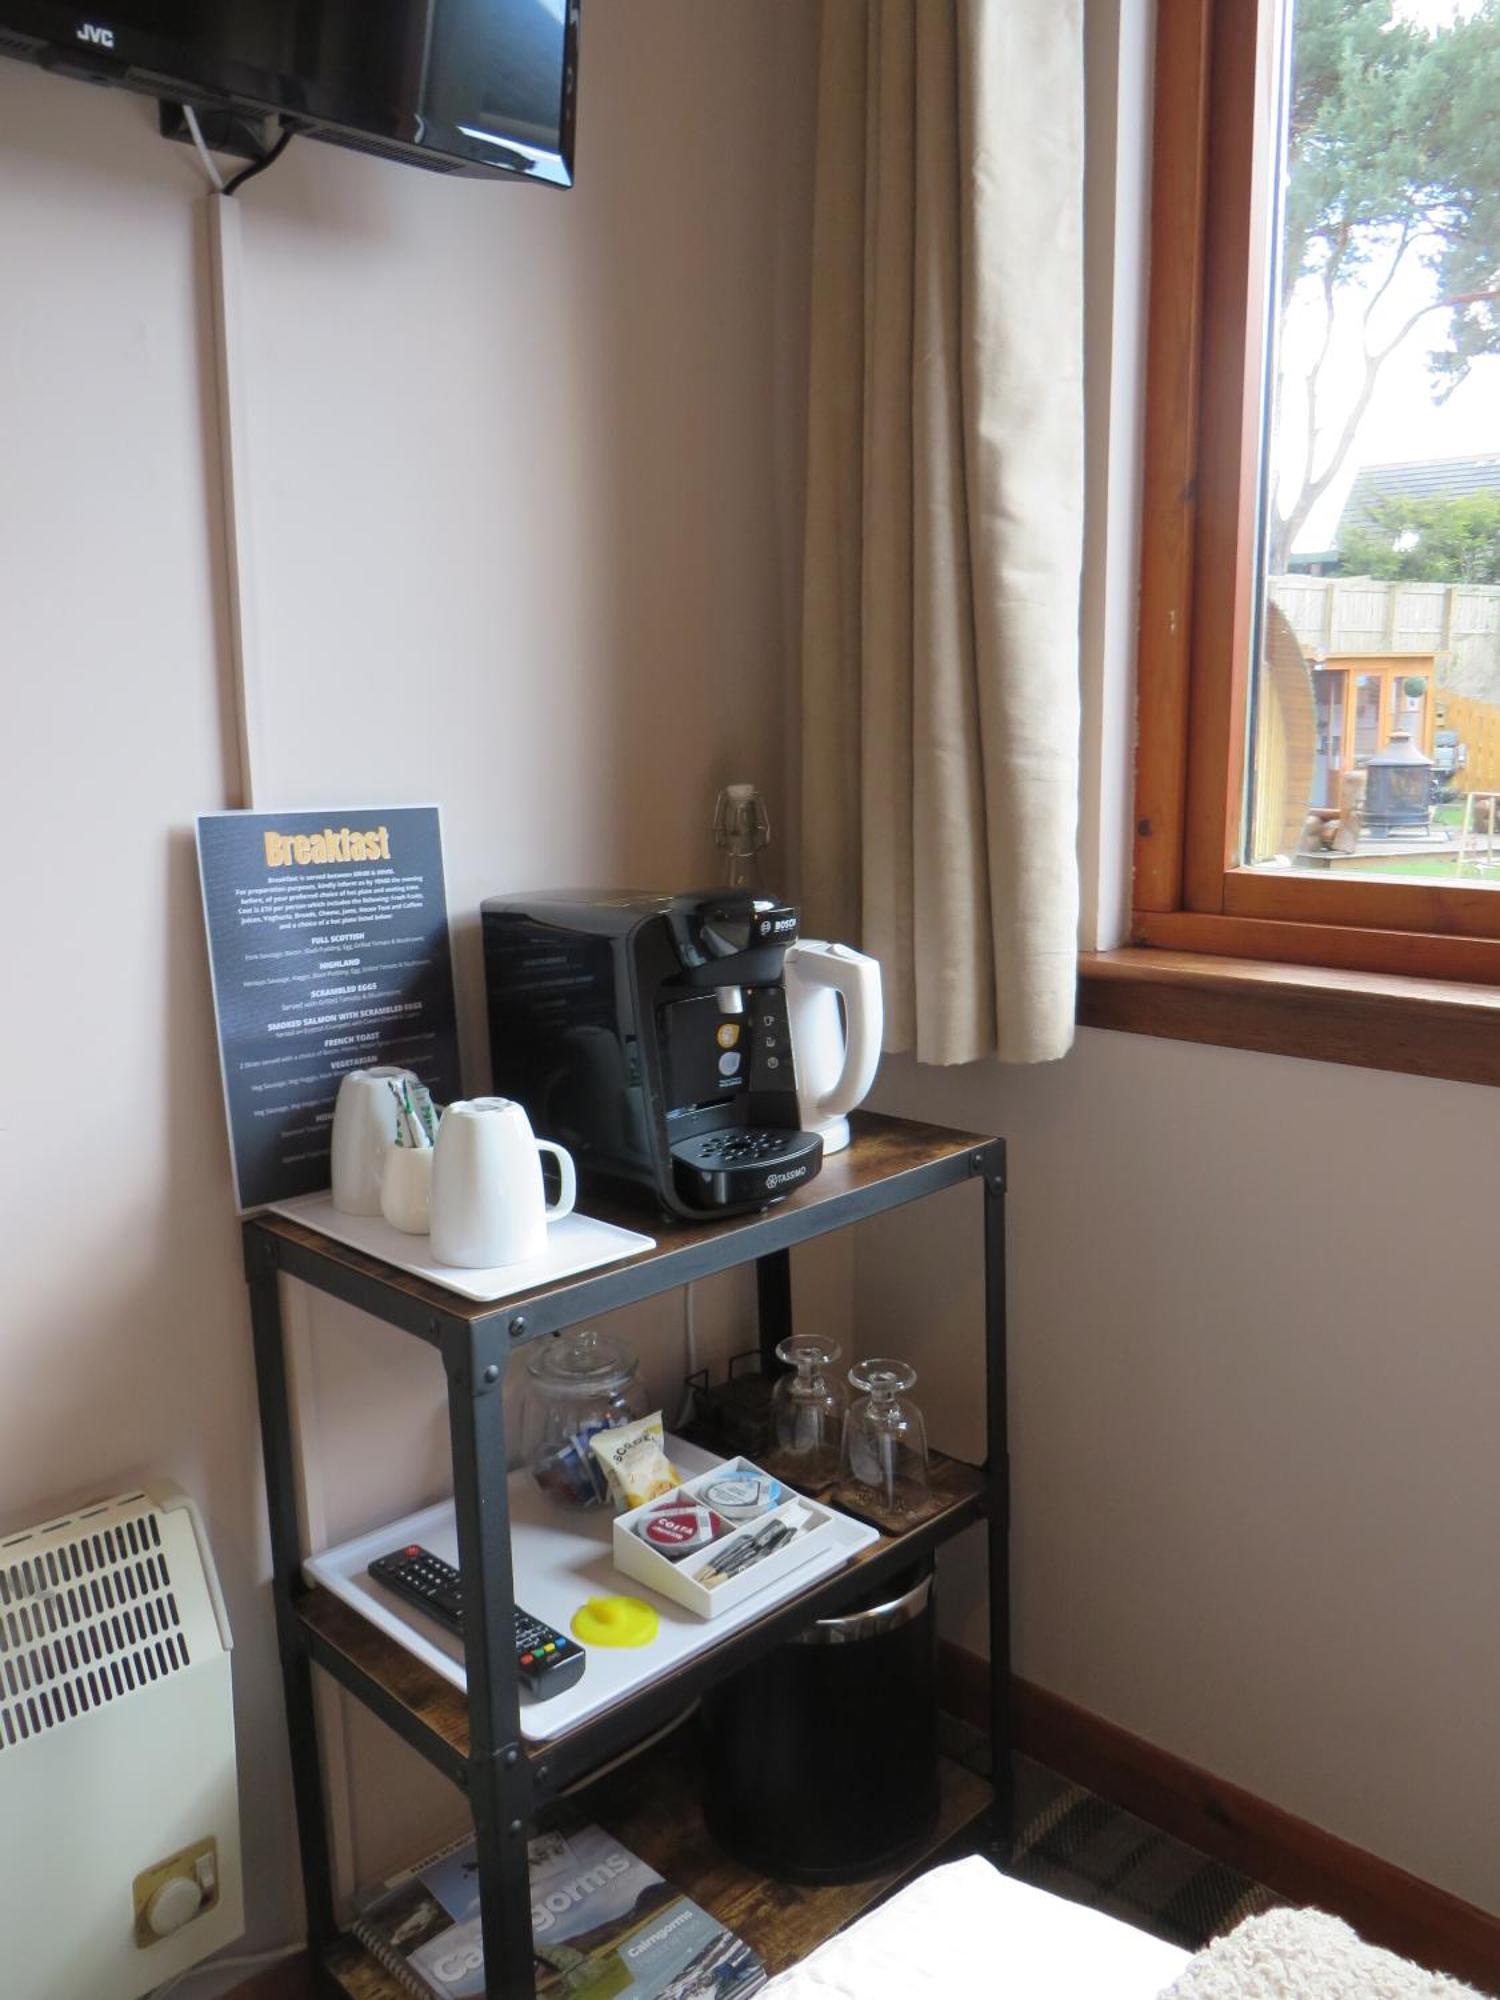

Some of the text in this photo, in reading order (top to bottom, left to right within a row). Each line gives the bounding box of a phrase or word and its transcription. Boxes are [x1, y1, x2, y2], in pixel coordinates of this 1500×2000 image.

[77, 23, 114, 48] JVC
[264, 826, 391, 867] Breakfast
[311, 932, 365, 945] FULL SCOTTISH
[319, 958, 360, 970] HIGHLAND
[310, 984, 357, 999] SCRAMBLED
[357, 982, 378, 992] EGGS
[267, 1019, 303, 1032] SMOKED
[303, 1014, 338, 1026] SALMON
[338, 1010, 359, 1020] WITH
[359, 1004, 404, 1018] SCRAMBLED
[324, 1036, 354, 1048] FRENCH
[356, 1031, 381, 1042] TOAST
[330, 1055, 378, 1069] VEGETARIAN
[777, 1166, 806, 1184] TASSIMO
[658, 1518, 694, 1535] COSTA
[627, 1909, 694, 1958] Cairngorms
